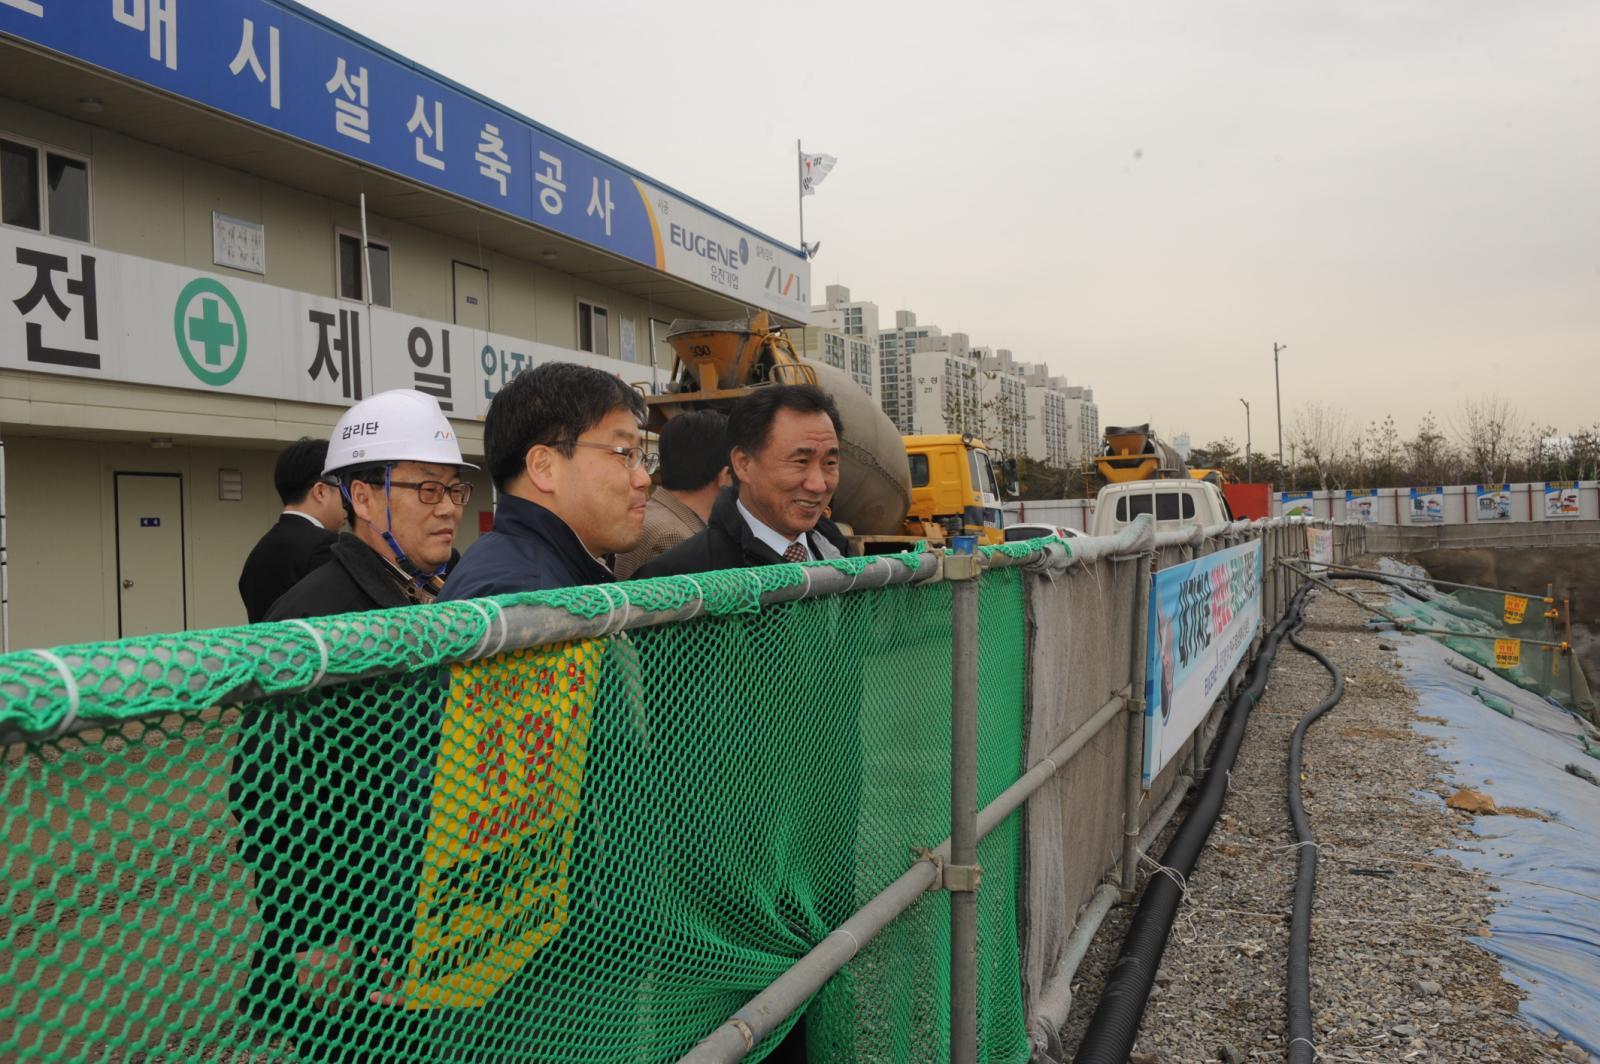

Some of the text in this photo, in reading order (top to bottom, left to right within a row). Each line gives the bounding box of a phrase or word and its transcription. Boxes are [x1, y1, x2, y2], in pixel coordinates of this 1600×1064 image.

[0, 0, 615, 237] 매시설신축공사
[670, 223, 738, 270] EUGENE
[710, 265, 739, 290] 유진기업
[342, 421, 379, 440] 감리단
